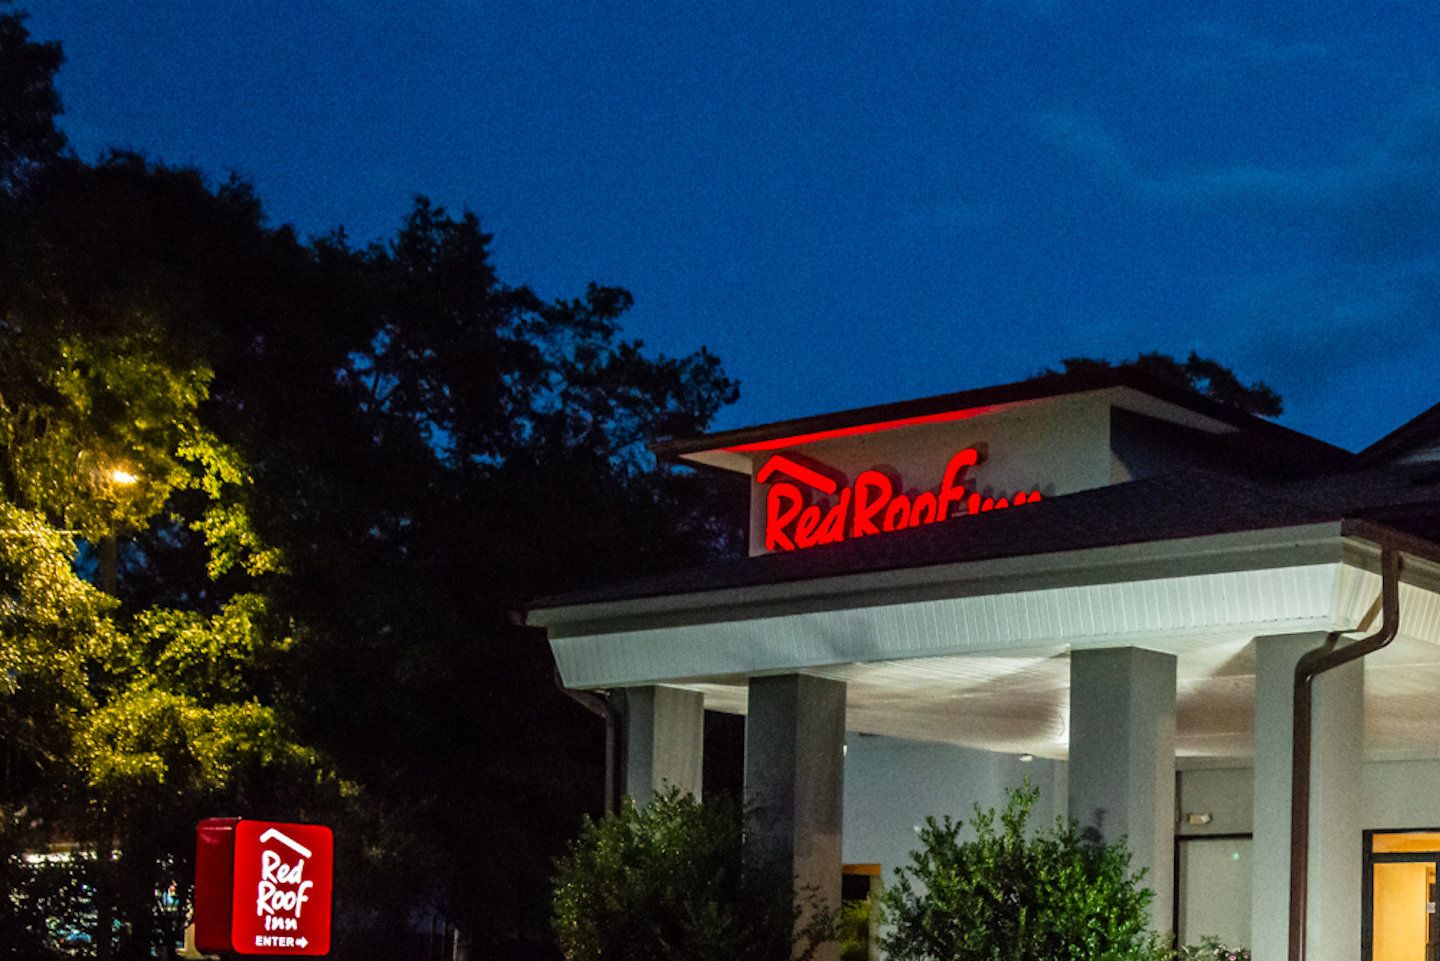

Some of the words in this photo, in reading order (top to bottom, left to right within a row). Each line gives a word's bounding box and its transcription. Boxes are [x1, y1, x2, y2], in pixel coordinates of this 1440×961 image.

[764, 482, 852, 551] Red
[852, 448, 978, 538] Roof
[261, 850, 305, 884] Red
[256, 880, 313, 919] Roof
[255, 935, 295, 947] ENTER
